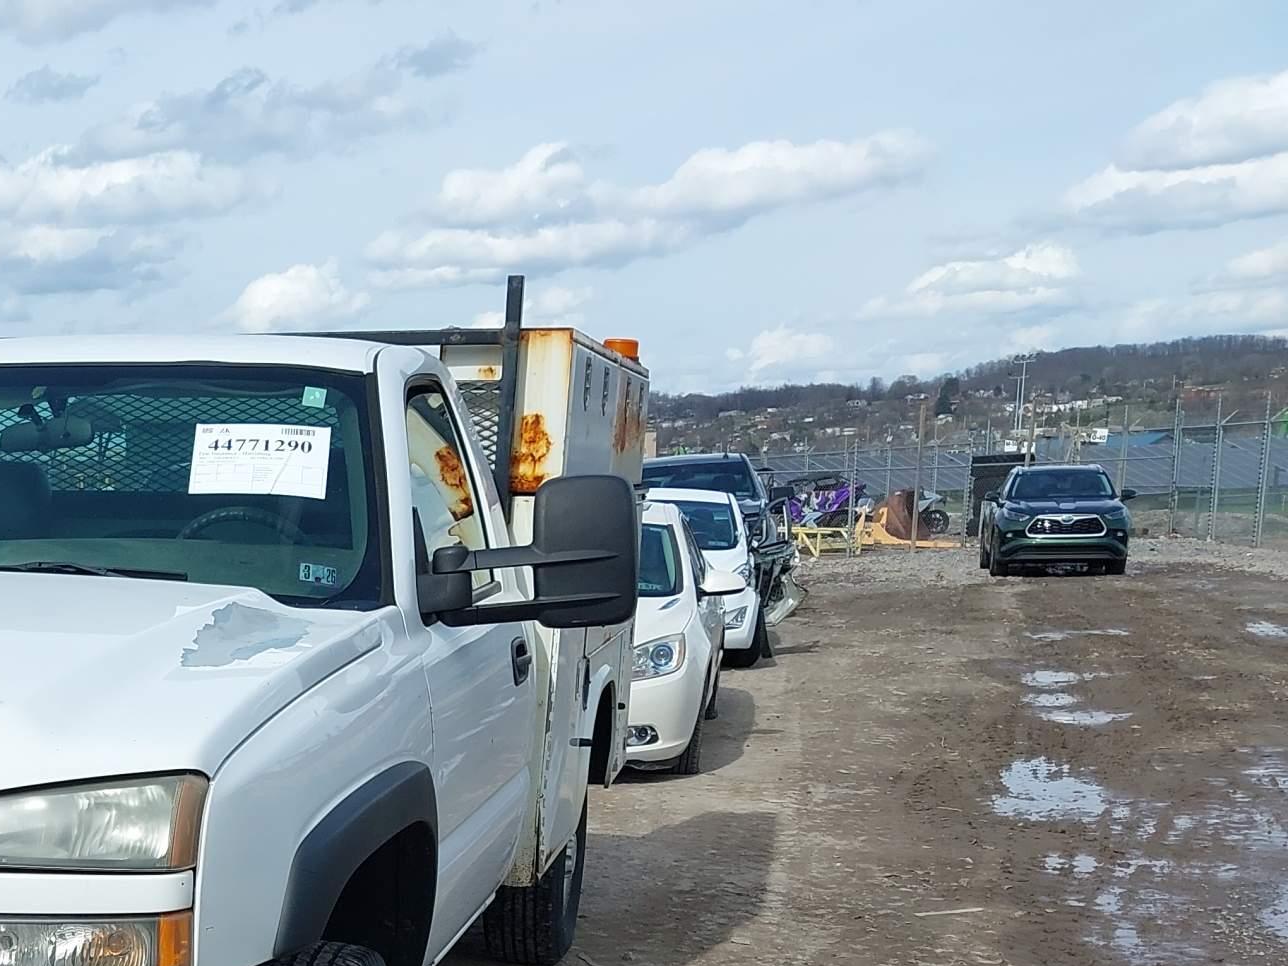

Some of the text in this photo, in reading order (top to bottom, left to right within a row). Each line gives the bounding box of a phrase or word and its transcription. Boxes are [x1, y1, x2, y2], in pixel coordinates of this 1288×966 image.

[208, 438, 312, 453] 44771290
[303, 564, 336, 584] 3 26
